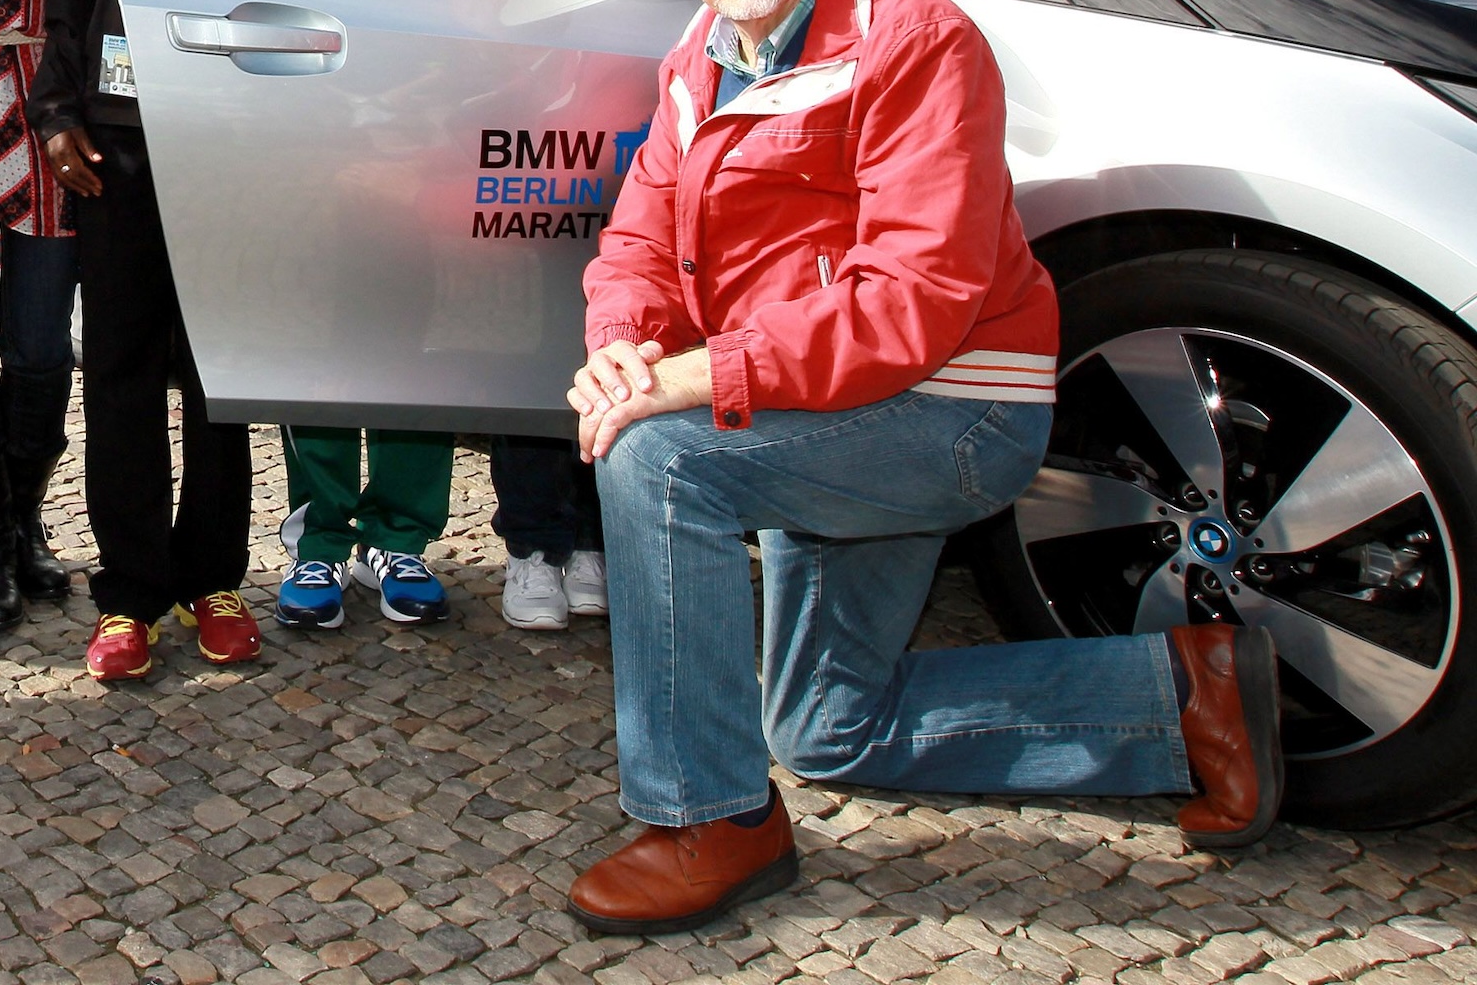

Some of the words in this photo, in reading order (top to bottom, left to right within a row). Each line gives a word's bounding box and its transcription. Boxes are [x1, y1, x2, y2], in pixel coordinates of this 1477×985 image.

[479, 129, 606, 170] BMW
[476, 176, 603, 205] BERLIN
[472, 211, 611, 239] MARAT
